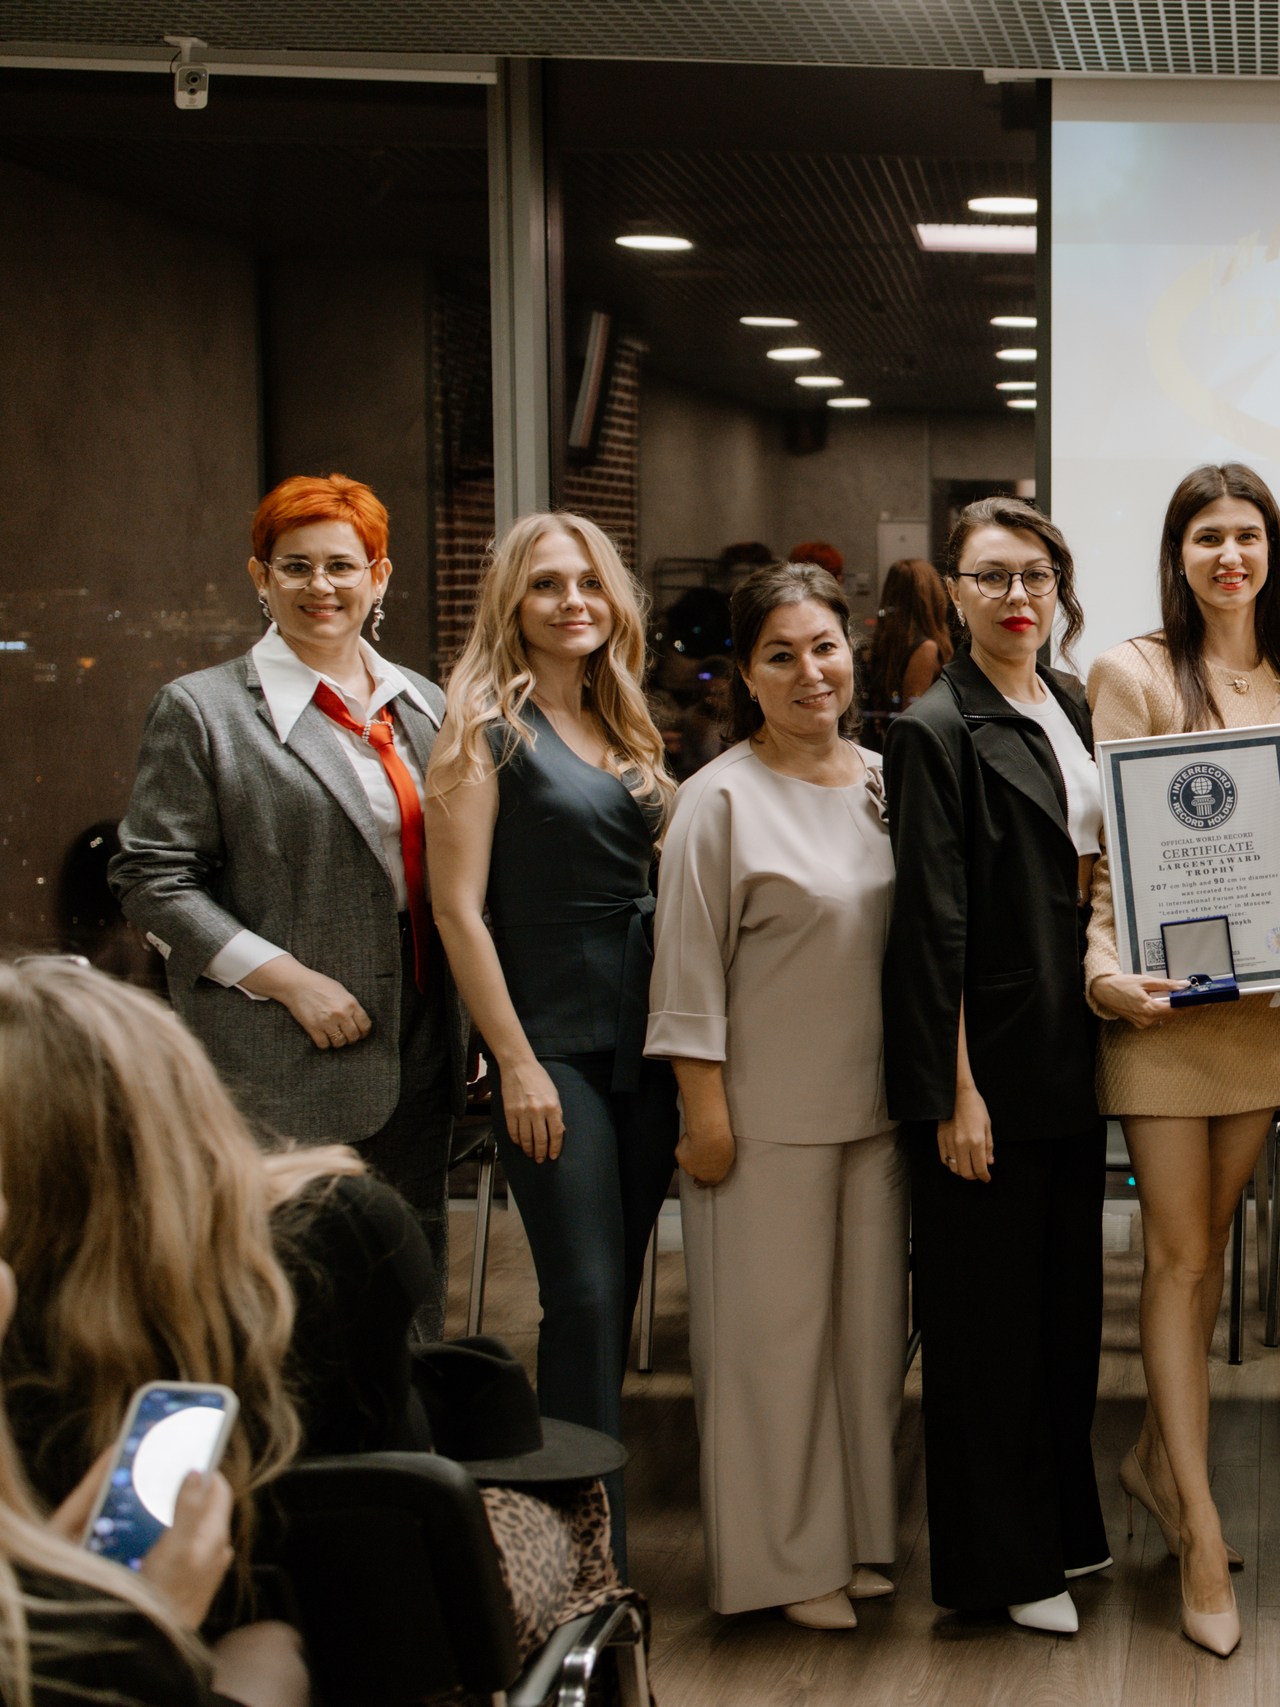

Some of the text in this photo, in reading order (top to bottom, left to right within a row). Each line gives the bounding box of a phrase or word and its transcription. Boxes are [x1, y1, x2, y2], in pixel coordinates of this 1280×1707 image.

[1172, 766, 1231, 794] INTERRECORD
[1172, 796, 1234, 827] RECORD HOLDER
[1161, 832, 1254, 847] OFFICIAL WORLD RECORD
[1162, 841, 1254, 860] CERTIFICATE
[1158, 854, 1262, 872] LARGEST AWARD
[1186, 865, 1236, 877] TROPHY
[1150, 883, 1168, 891] 207
[1182, 881, 1198, 889] high
[1200, 879, 1212, 887] and
[1213, 877, 1225, 885] 90
[1248, 873, 1279, 881] diameter
[1166, 897, 1211, 908] International
[1212, 894, 1235, 903] Forum
[1250, 890, 1272, 898] Award
[1196, 887, 1222, 896] created
